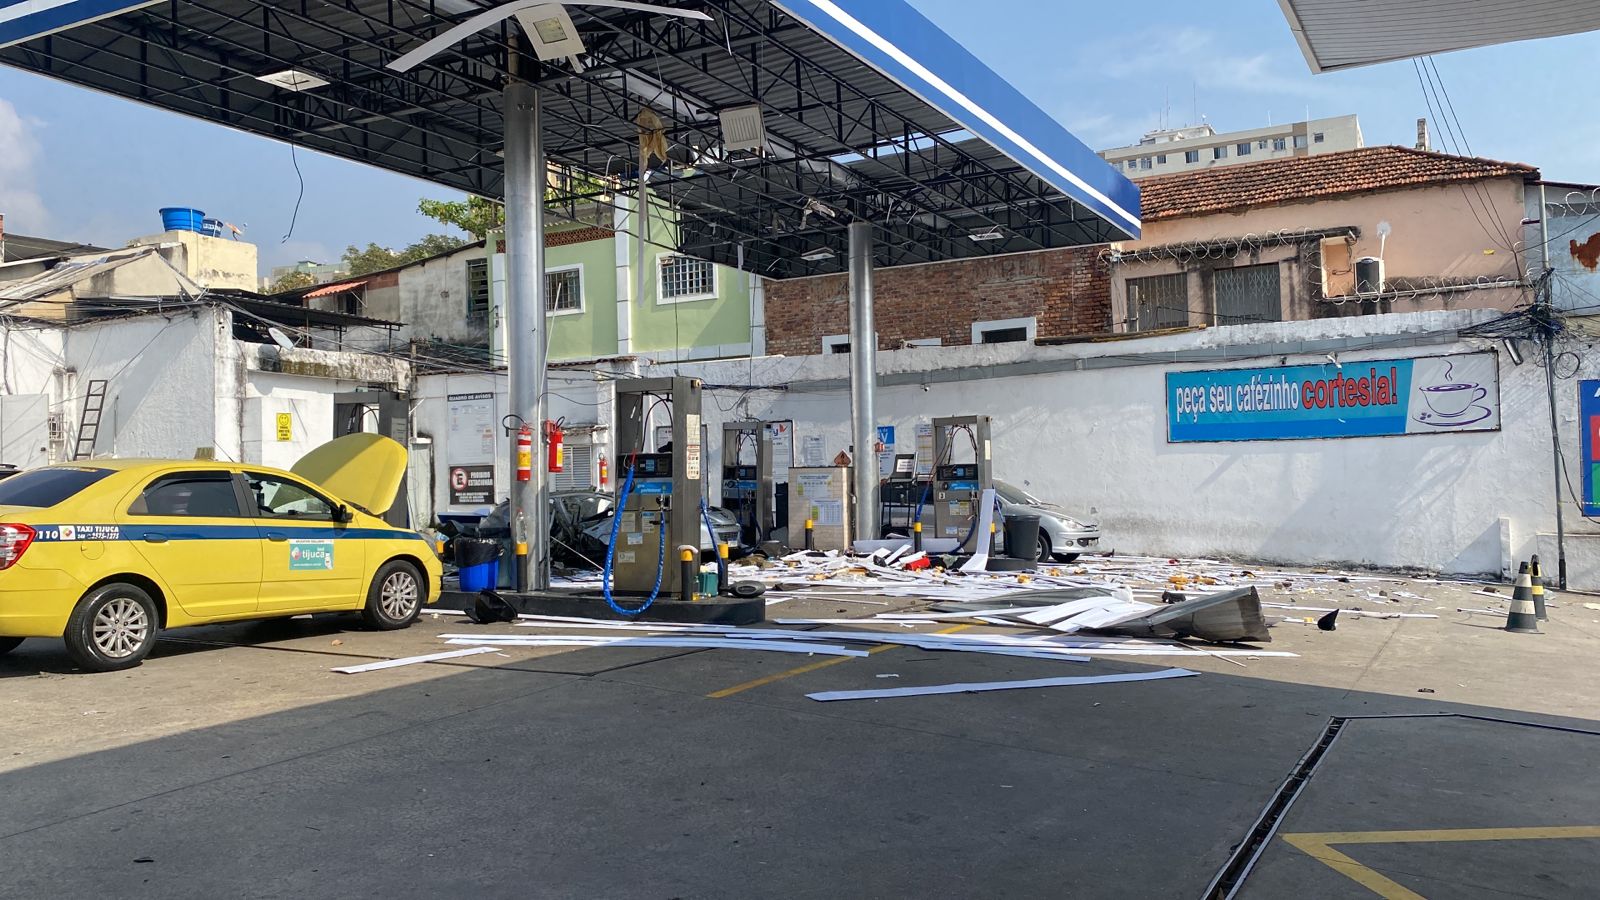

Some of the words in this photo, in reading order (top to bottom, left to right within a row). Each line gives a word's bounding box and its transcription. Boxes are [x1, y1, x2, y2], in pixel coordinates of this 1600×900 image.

[1176, 386, 1206, 423] peça
[1209, 385, 1232, 413] seu
[1236, 374, 1299, 412] cafézinho
[1301, 366, 1398, 410] cortesia!
[302, 549, 325, 560] tijuca
